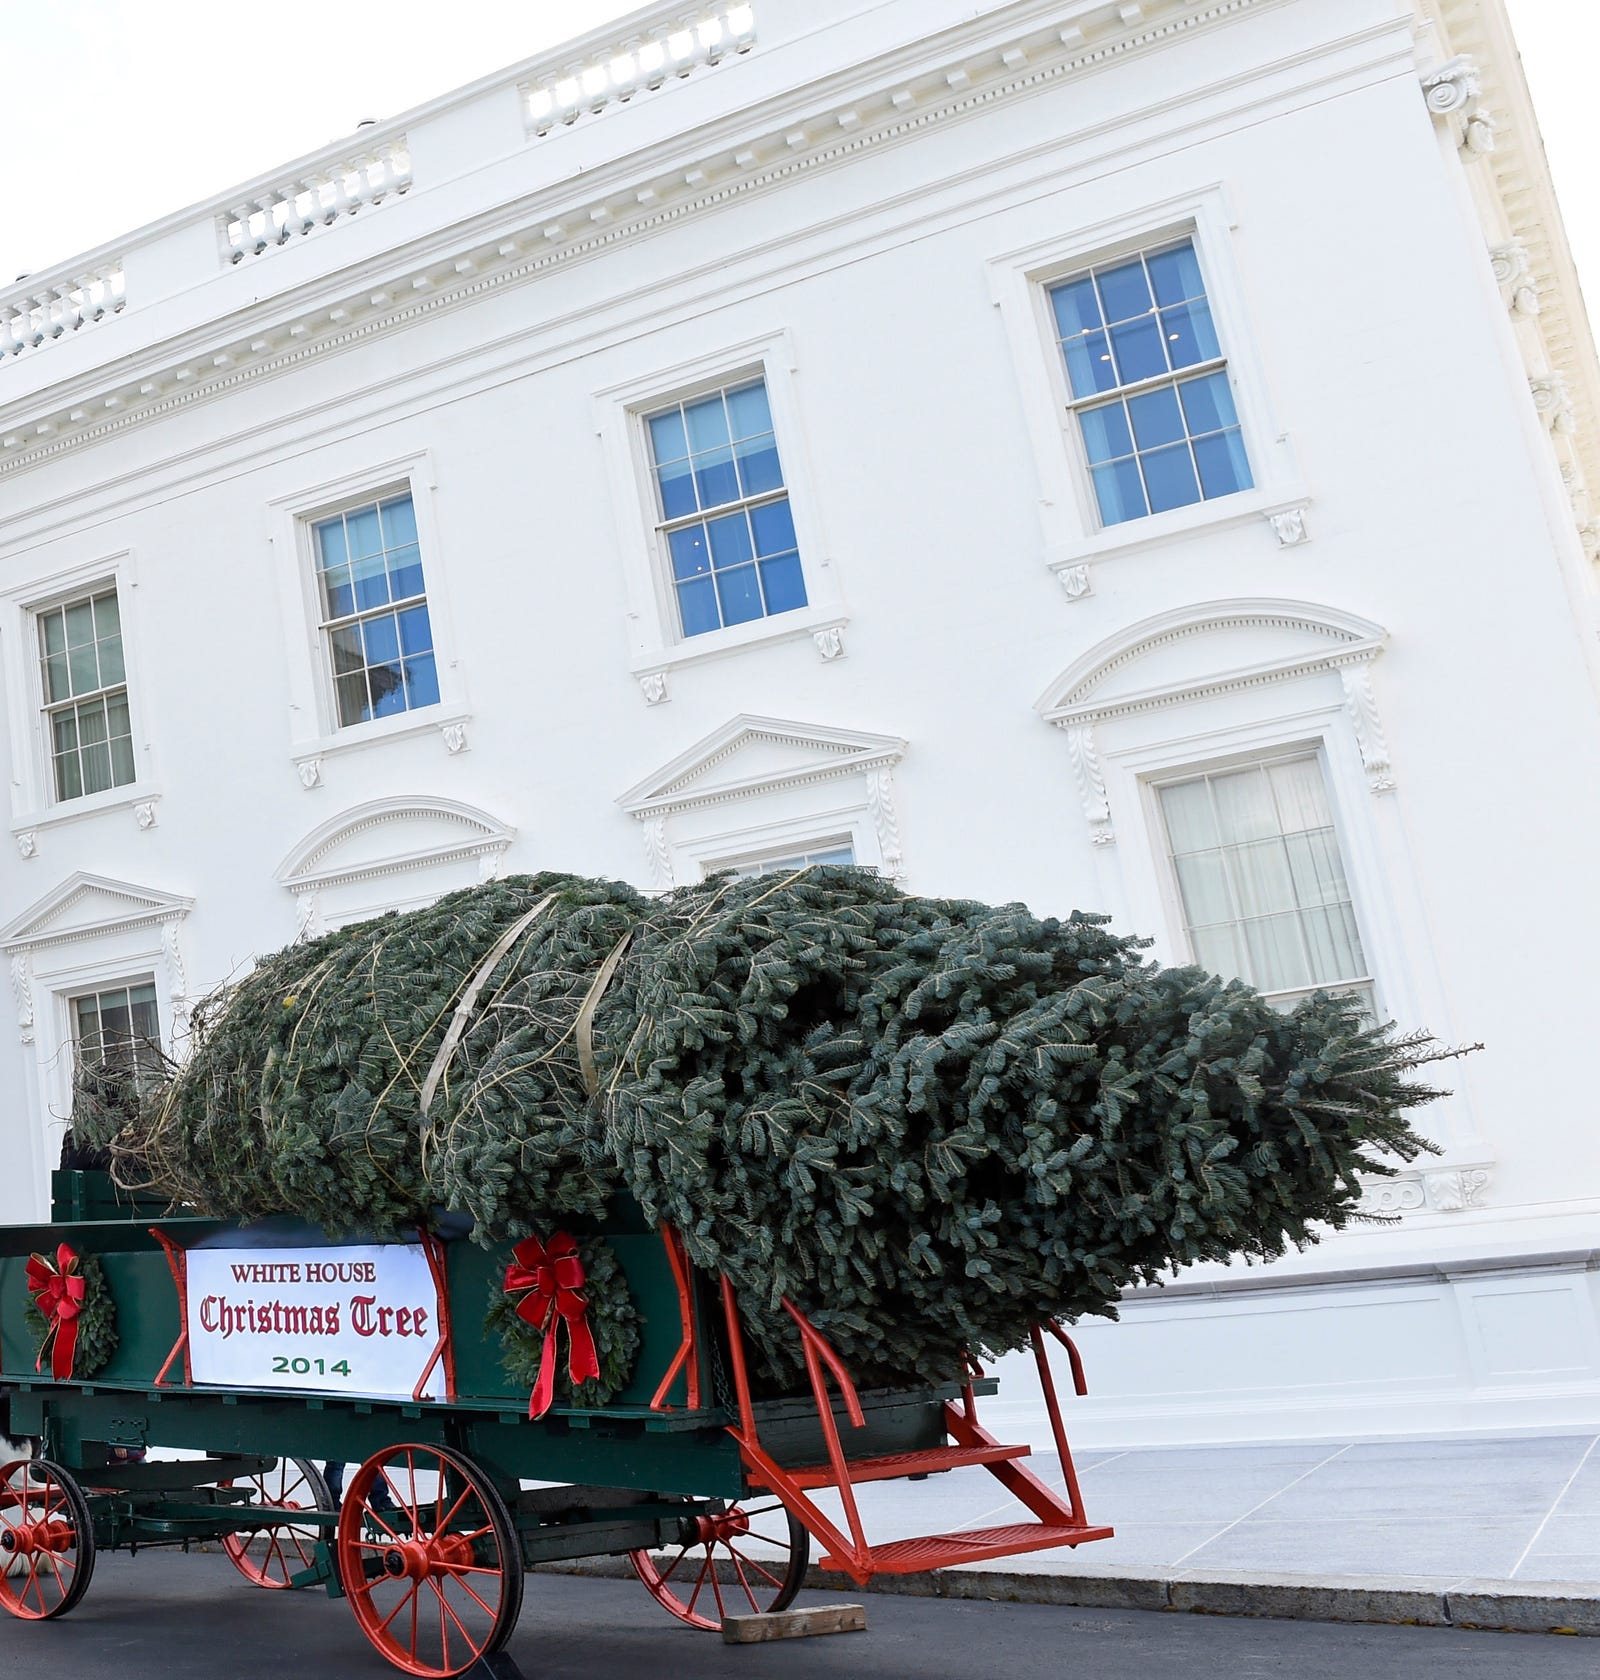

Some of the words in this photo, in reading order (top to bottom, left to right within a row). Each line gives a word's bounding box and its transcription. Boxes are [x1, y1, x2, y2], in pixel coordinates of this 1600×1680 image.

[231, 1264, 301, 1283] WHITE
[306, 1262, 376, 1283] HOUSE
[200, 1294, 340, 1339] Christmas
[350, 1295, 428, 1337] Tree
[272, 1356, 352, 1376] 2014
